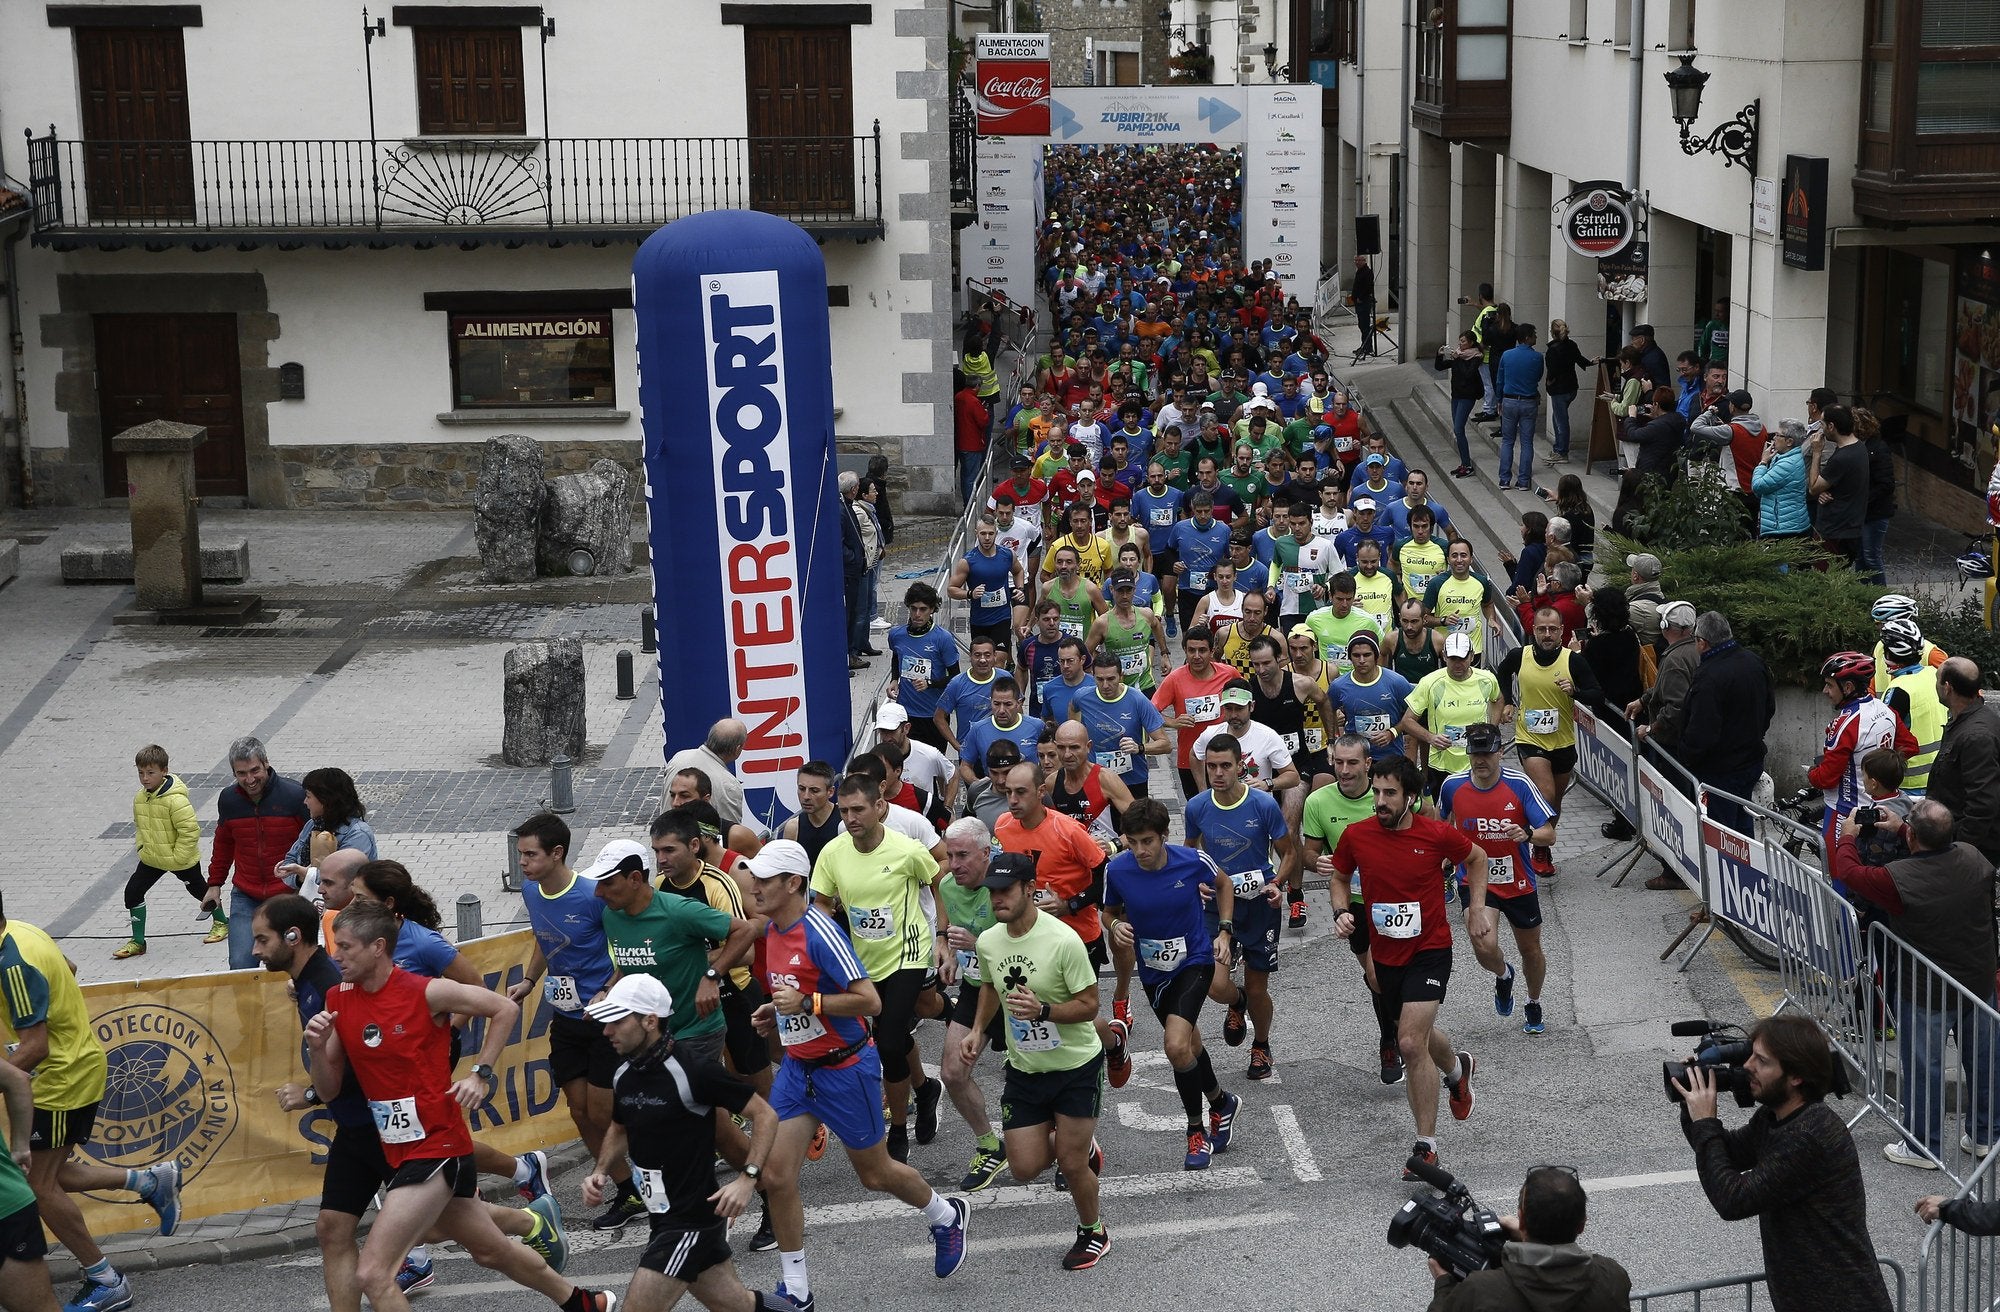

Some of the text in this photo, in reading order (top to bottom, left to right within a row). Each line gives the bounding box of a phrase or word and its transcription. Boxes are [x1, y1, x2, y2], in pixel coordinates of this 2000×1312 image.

[988, 48, 1036, 56] BACAICOA
[1318, 63, 1328, 79] P
[1117, 122, 1180, 132] PAMPLONA
[1575, 213, 1620, 225] Estrella
[1576, 225, 1619, 237] Galicia
[465, 319, 600, 336] ALIMENTACIÓN
[710, 294, 804, 774] INTERSPORT
[1294, 579, 1310, 587] 128
[908, 664, 927, 674] 708
[1125, 658, 1143, 670] 874
[1195, 703, 1215, 714] 647
[1365, 722, 1385, 731] 720
[1534, 717, 1554, 726] 744
[1106, 758, 1126, 768] 112
[1580, 730, 1626, 811] Noticias
[1720, 831, 1748, 862] Diario de
[1491, 866, 1507, 875] 68
[1234, 881, 1258, 895] 608
[860, 918, 886, 929] 622
[1384, 914, 1413, 927] 807
[1152, 949, 1179, 962] 467
[553, 988, 572, 1000] 895
[784, 1016, 810, 1032] 430
[97, 1014, 200, 1049] OTECCION
[1022, 1028, 1049, 1041] 213
[176, 1079, 228, 1169] GILANCIA
[382, 1113, 410, 1130] 745
